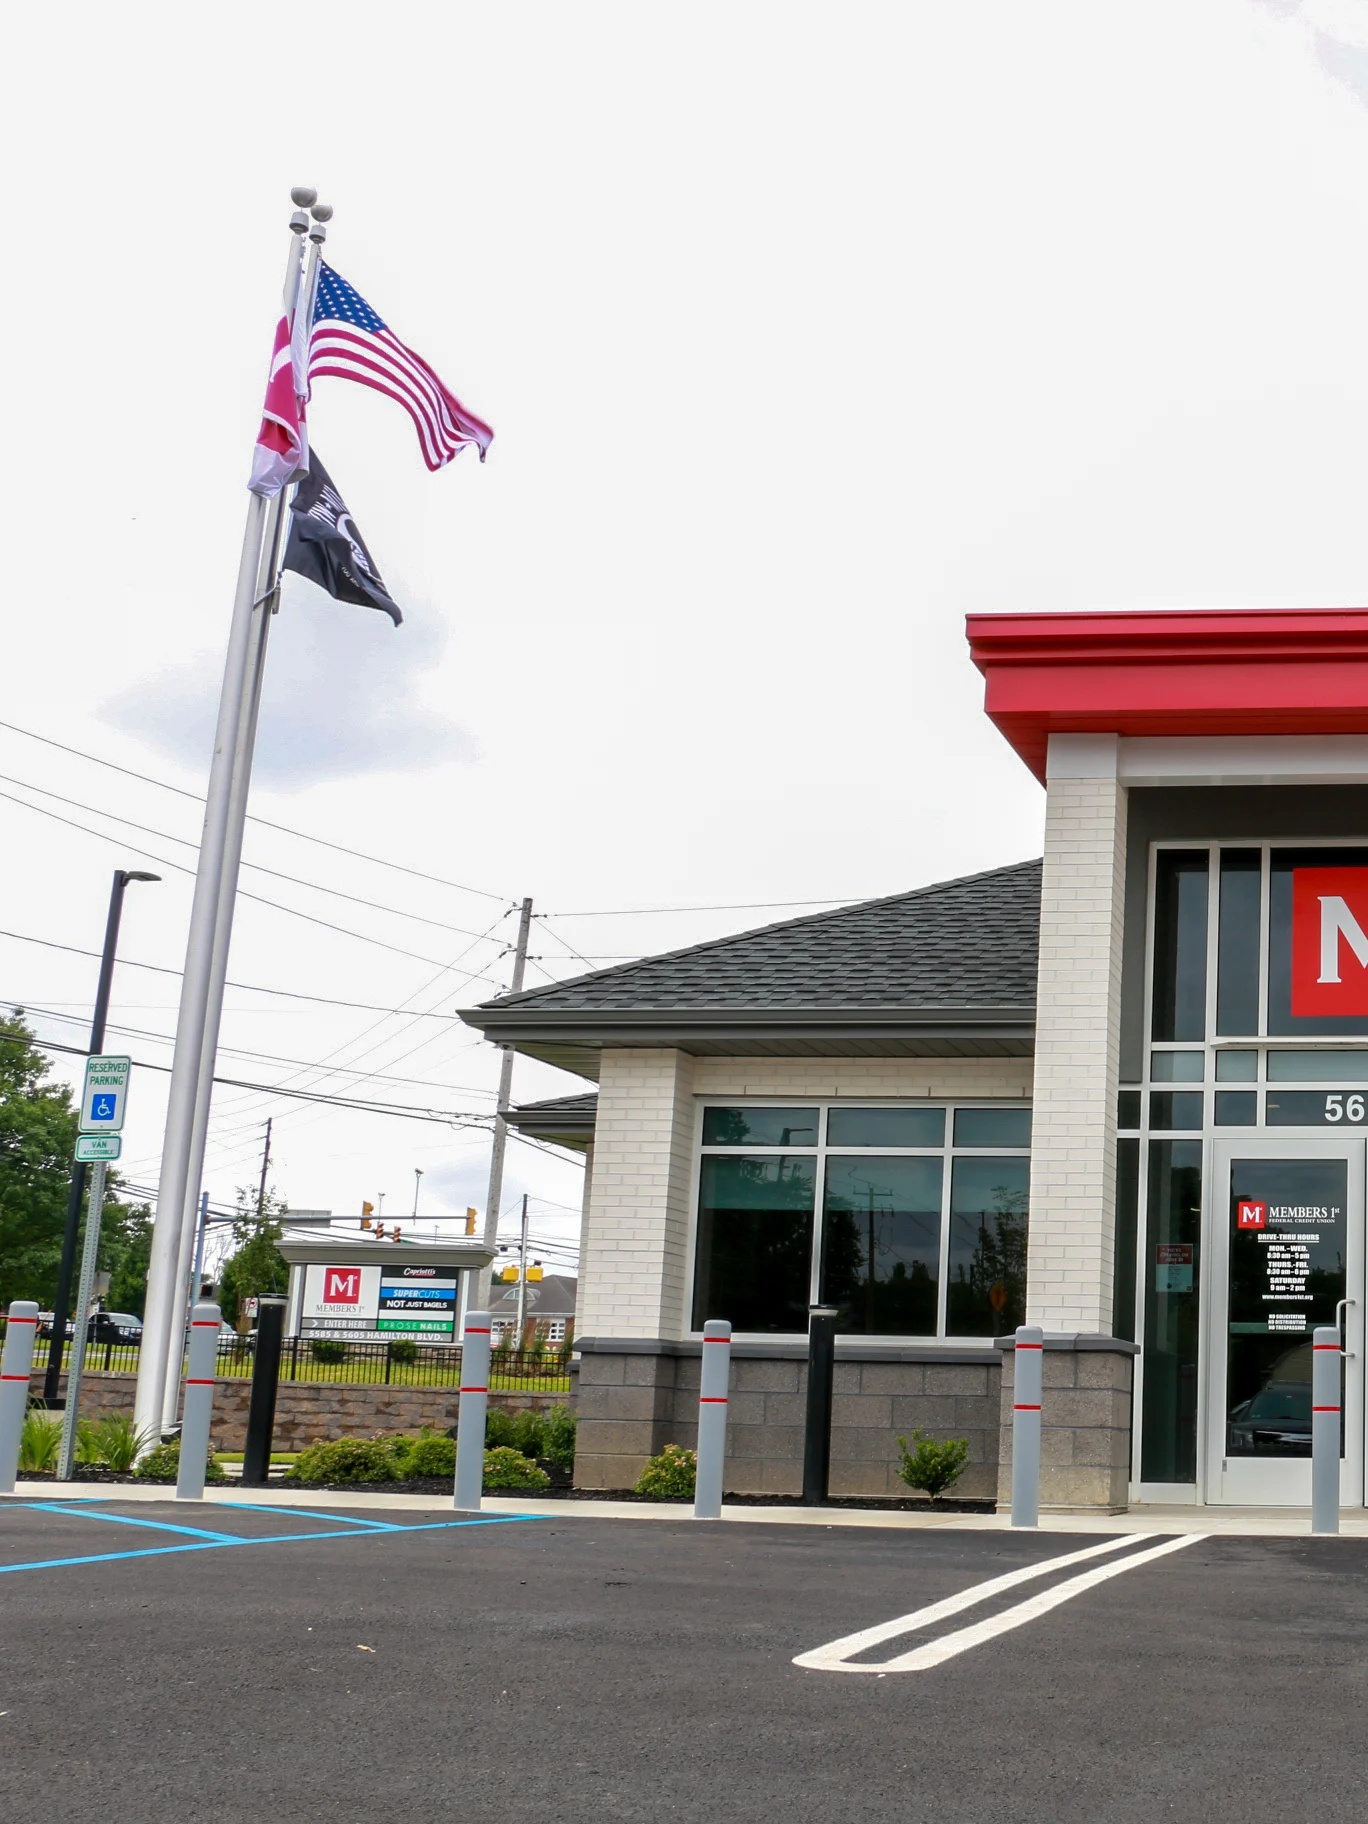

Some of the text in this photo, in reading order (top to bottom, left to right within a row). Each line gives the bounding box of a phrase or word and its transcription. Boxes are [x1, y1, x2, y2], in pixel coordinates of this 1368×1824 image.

[88, 1063, 128, 1072] RESERVED
[90, 1076, 124, 1085] PARKING
[1269, 1206, 1340, 1218] MEMBERS 1st
[393, 1290, 440, 1298] SUPERCUTS
[316, 1304, 356, 1312] MEMBERS
[386, 1300, 406, 1308] NOT
[324, 1320, 347, 1328] ENTER
[384, 1322, 417, 1330] PROSE
